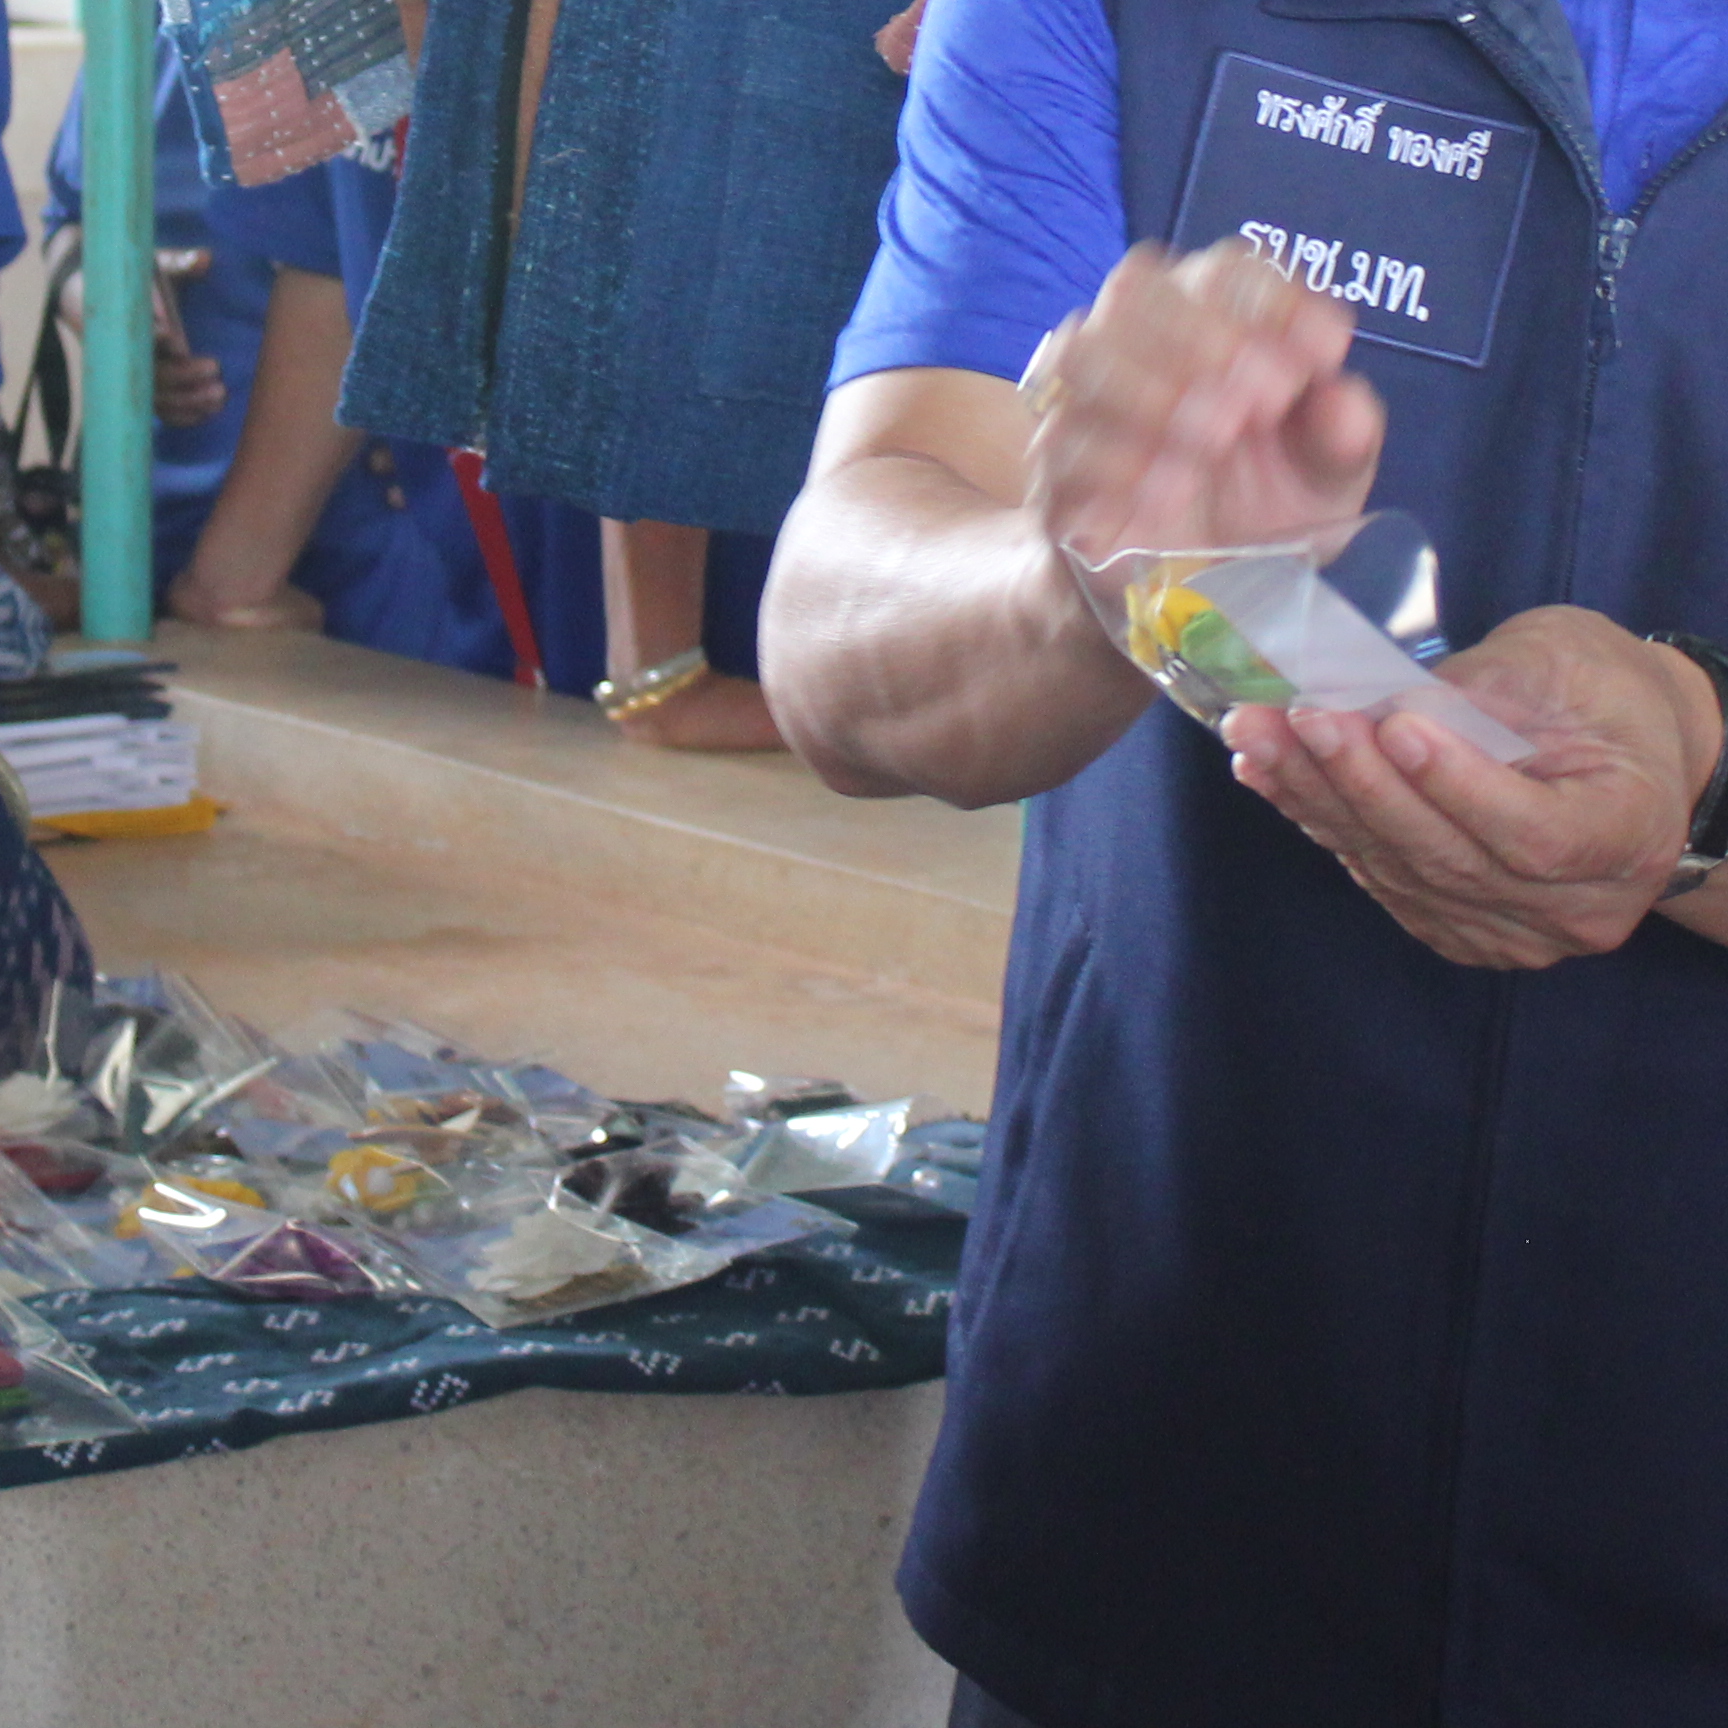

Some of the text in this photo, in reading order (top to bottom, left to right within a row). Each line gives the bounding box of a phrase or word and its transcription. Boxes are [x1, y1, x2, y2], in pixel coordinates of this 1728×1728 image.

[1255, 89, 1492, 181] ทรงศักดิ์ ทองศรี
